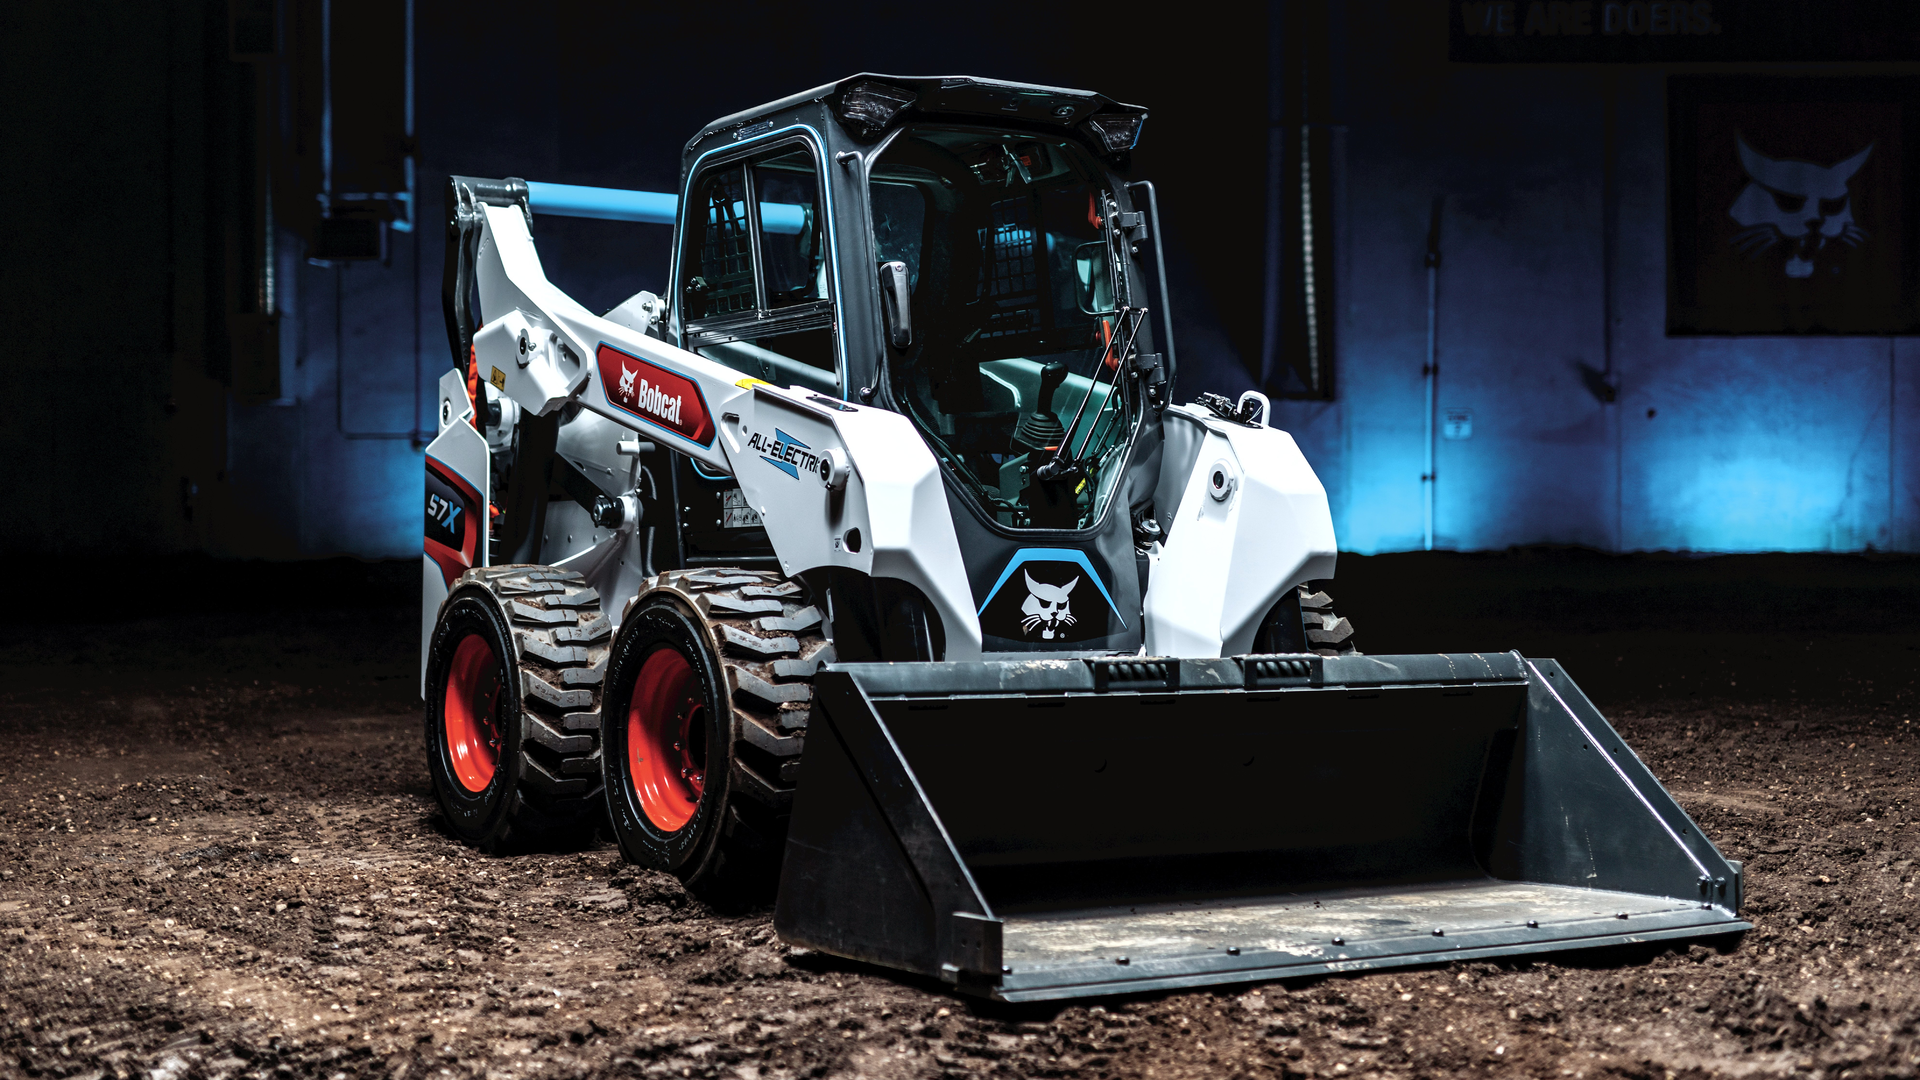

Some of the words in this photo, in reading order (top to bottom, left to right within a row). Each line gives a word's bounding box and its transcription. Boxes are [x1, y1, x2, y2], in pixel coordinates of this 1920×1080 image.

[1464, 2, 1514, 34] WE
[1526, 2, 1592, 34] ARE
[1603, 2, 1721, 34] DOERS.
[638, 378, 681, 425] Bobcat
[747, 432, 820, 473] ALL-ELECTRI
[427, 493, 462, 534] S7X
